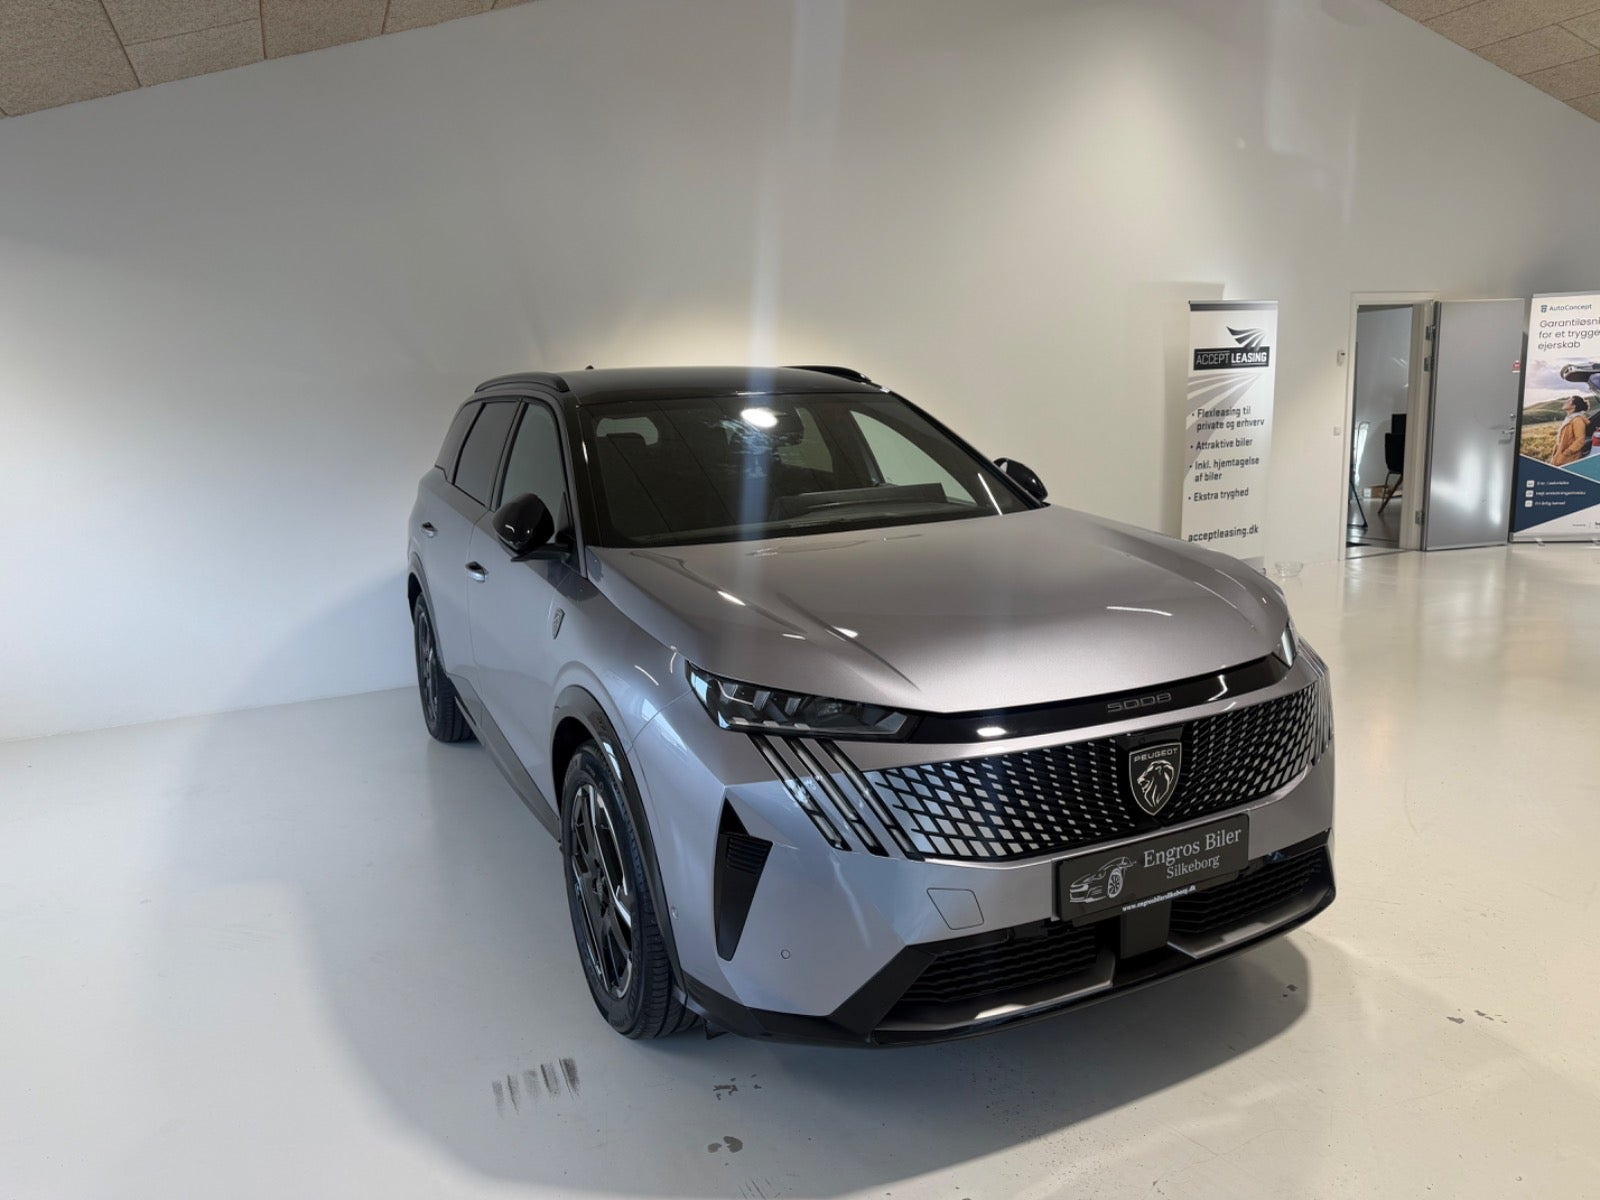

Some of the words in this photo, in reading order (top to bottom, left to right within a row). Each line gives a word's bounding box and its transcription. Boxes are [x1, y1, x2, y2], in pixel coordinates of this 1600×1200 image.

[1539, 331, 1552, 339] for
[1538, 341, 1581, 352] ejerskab
[1196, 353, 1230, 365] ACCEPT
[1231, 352, 1267, 363] LEASING
[1197, 406, 1241, 418] Flexleasing
[1243, 405, 1252, 415] til
[1196, 421, 1224, 433] private
[1226, 421, 1235, 430] og
[1236, 418, 1265, 428] erhverv
[1196, 439, 1235, 450] Attraktive
[1235, 437, 1253, 447] biler
[1213, 456, 1260, 470] hjemtagelse
[1195, 472, 1203, 482] af
[1204, 472, 1222, 481] biler
[1194, 492, 1219, 502] Ekstra
[1220, 487, 1249, 500] tryghed
[1188, 524, 1259, 542] acceptleasing.dk
[1134, 747, 1178, 762] PEUGEOT
[1143, 839, 1201, 868] Engros
[1205, 828, 1242, 851] Biler
[1166, 854, 1221, 880] Silkeborg
